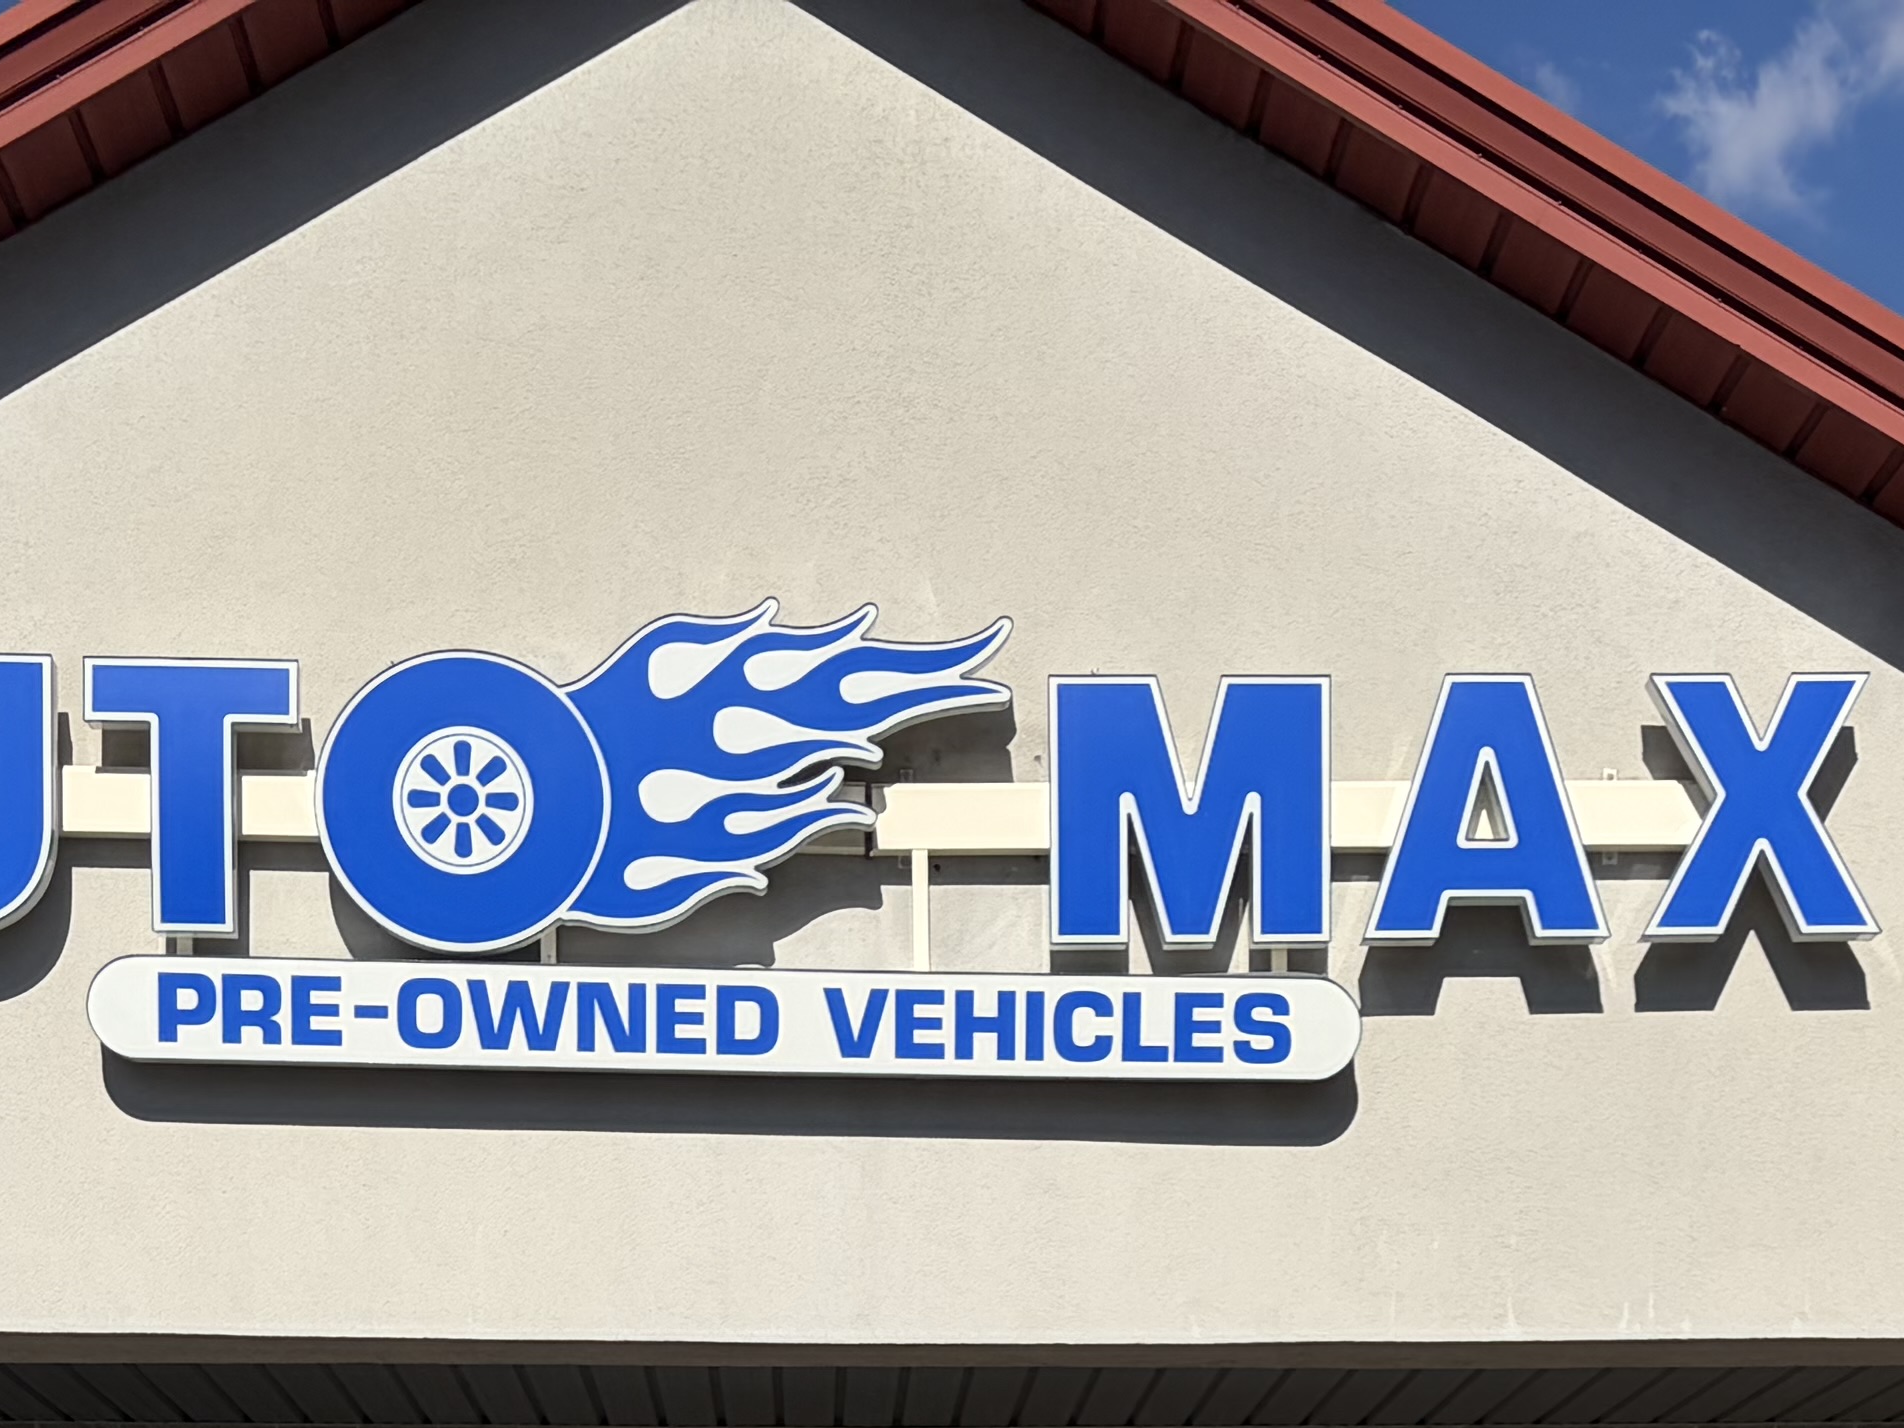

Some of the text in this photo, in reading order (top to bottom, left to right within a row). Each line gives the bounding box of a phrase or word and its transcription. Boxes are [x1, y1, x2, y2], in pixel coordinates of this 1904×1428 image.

[1049, 674, 1877, 944] MAX
[157, 971, 1293, 1066] PRE-OWNED VEHICLES
